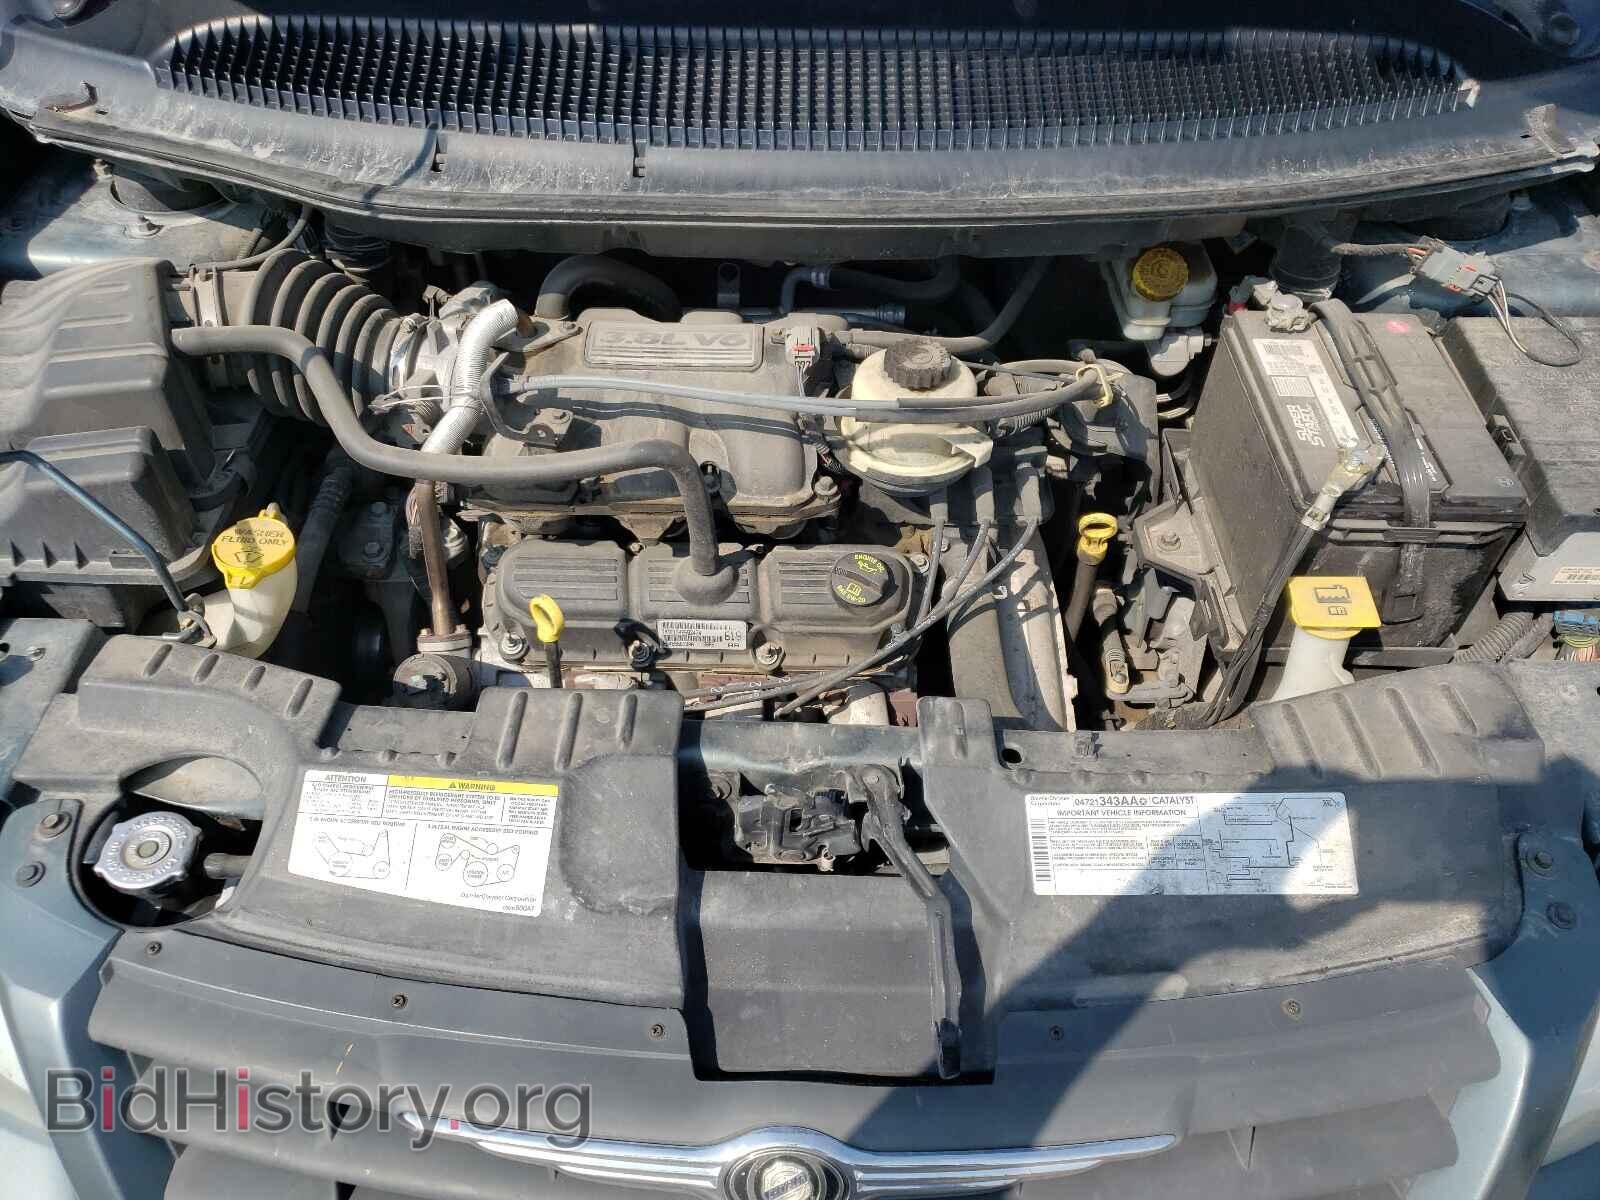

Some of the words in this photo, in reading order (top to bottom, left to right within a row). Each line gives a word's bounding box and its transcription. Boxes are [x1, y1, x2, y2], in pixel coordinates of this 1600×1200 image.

[1286, 404, 1308, 441] SUPER
[325, 774, 367, 783] ATTENTION
[458, 782, 496, 791] WARNING
[1151, 795, 1194, 805] CATALYST
[1056, 809, 1099, 817] IMPORTANT
[1101, 809, 1132, 817] VEHICLE
[1133, 808, 1187, 816] INFORMATION
